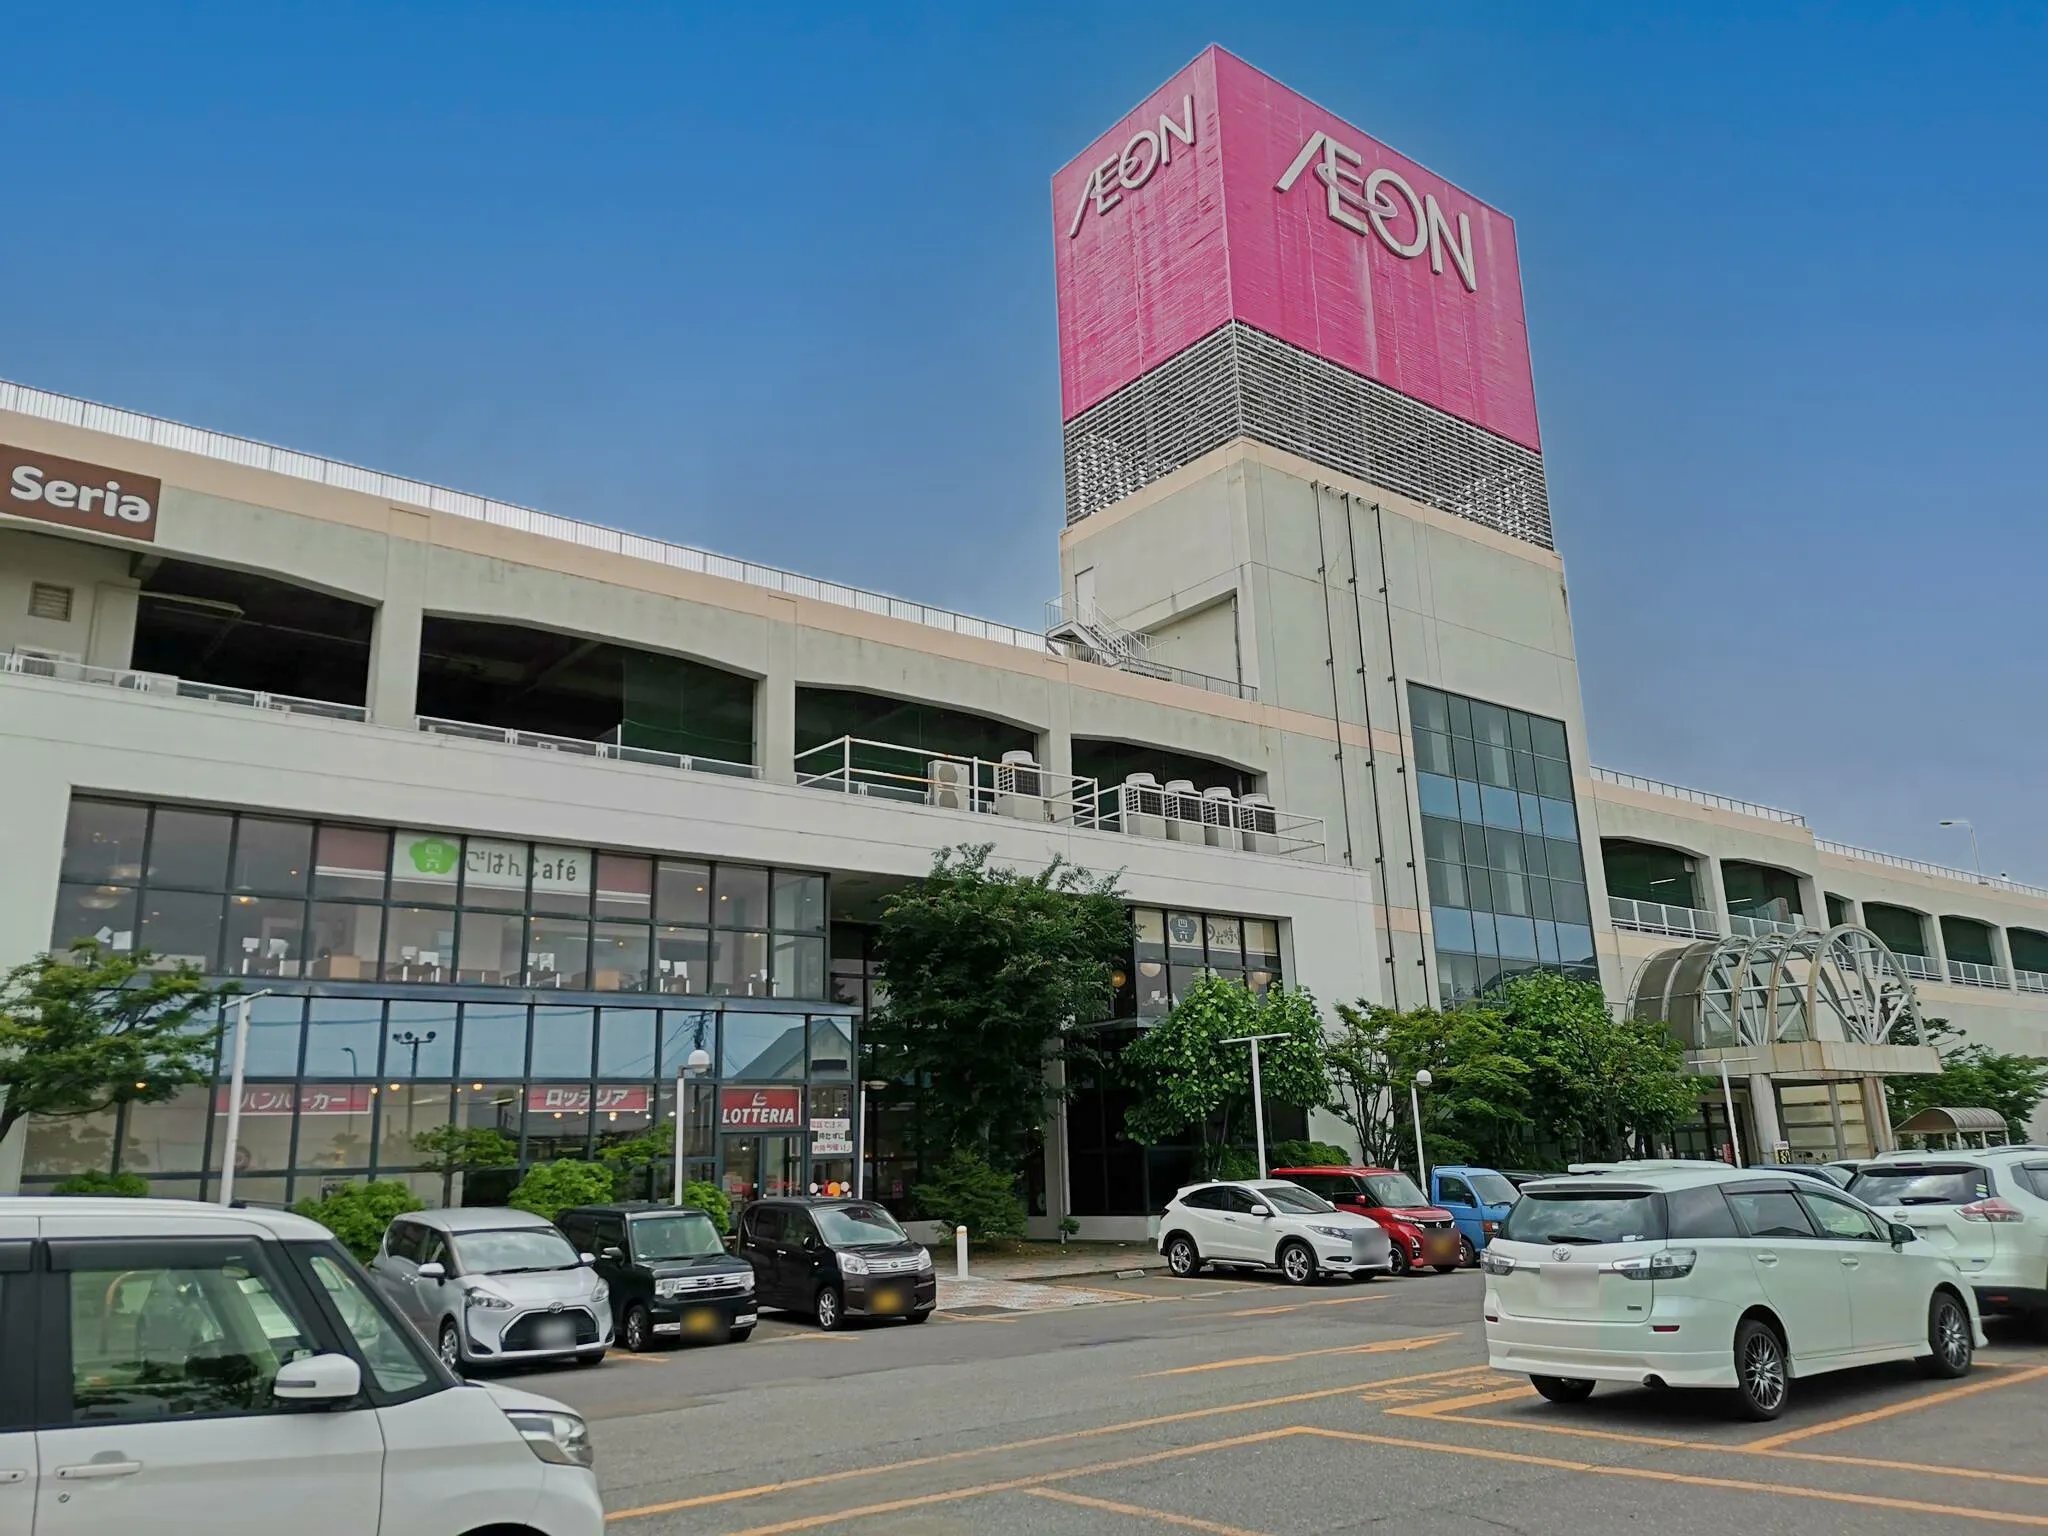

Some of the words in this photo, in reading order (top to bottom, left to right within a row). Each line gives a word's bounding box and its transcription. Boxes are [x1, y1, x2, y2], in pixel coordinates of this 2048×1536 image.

[10, 465, 151, 523] Seria
[466, 850, 524, 877] ごはん
[545, 1088, 629, 1107] ロッテリア
[722, 1107, 795, 1124] LOTTERIA
